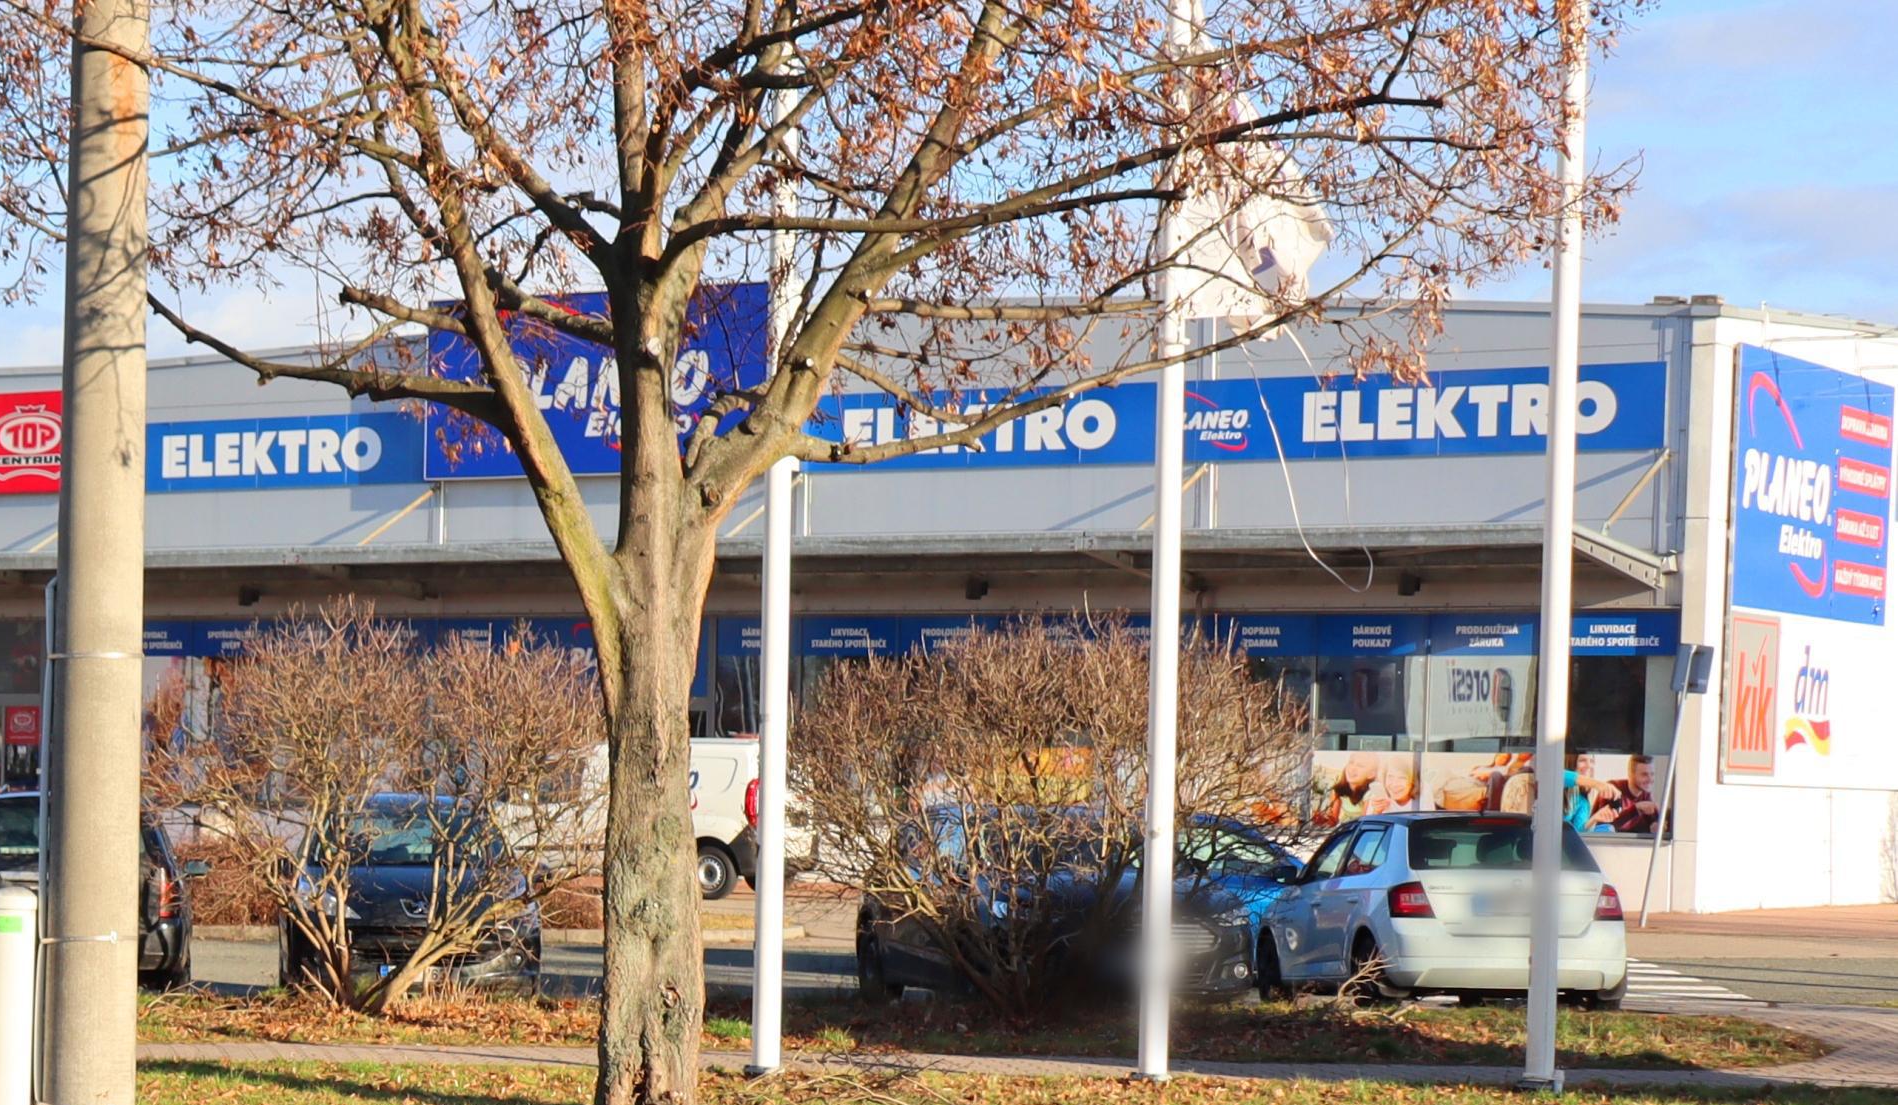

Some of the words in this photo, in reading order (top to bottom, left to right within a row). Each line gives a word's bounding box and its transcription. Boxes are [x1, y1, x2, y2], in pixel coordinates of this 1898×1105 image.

[518, 350, 710, 410] LANO
[1302, 380, 1617, 443] ELEKTRO
[5, 422, 56, 450] TOP
[1199, 431, 1242, 441] Elektro
[162, 426, 383, 479] ELEKTRO
[1742, 448, 1832, 525] PLANEO
[1779, 523, 1823, 560] Elektro
[1241, 626, 1281, 636] DOPRAVA
[1352, 624, 1392, 636] DÁRKOVÉ
[1455, 623, 1519, 635] PRODLOUŽENÁ
[1589, 624, 1637, 635] LIKVIDACE
[1243, 638, 1278, 648] ZDARMA
[1352, 638, 1391, 648] POUKAZY
[1469, 636, 1504, 648] ZÁRUKA
[1570, 636, 1605, 647] TARÉHO
[1794, 645, 1829, 716] dm
